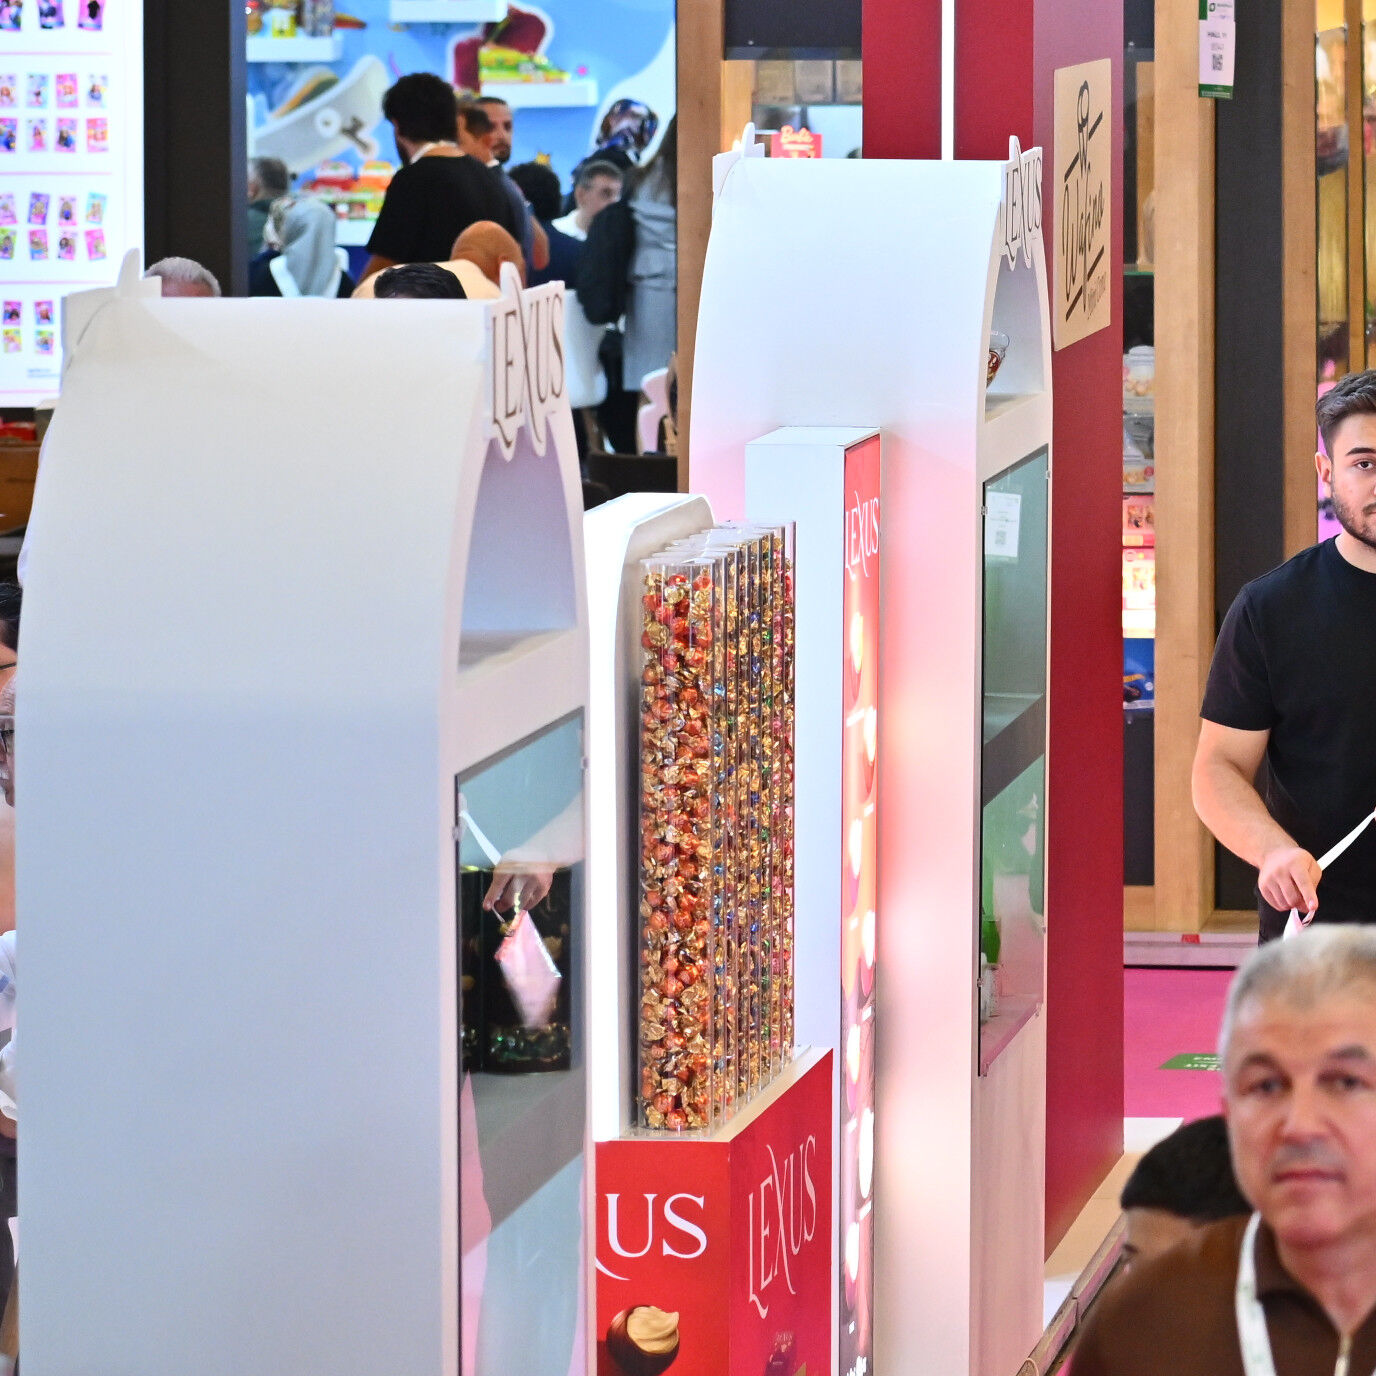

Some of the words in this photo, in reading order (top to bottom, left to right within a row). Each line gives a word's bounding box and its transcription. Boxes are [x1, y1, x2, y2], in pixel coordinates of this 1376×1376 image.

[1005, 144, 1042, 262] LEXUS
[493, 276, 564, 448] LEXUS
[845, 490, 879, 581] LEXUS
[595, 1193, 708, 1281] US
[749, 1134, 816, 1319] LEXUS
